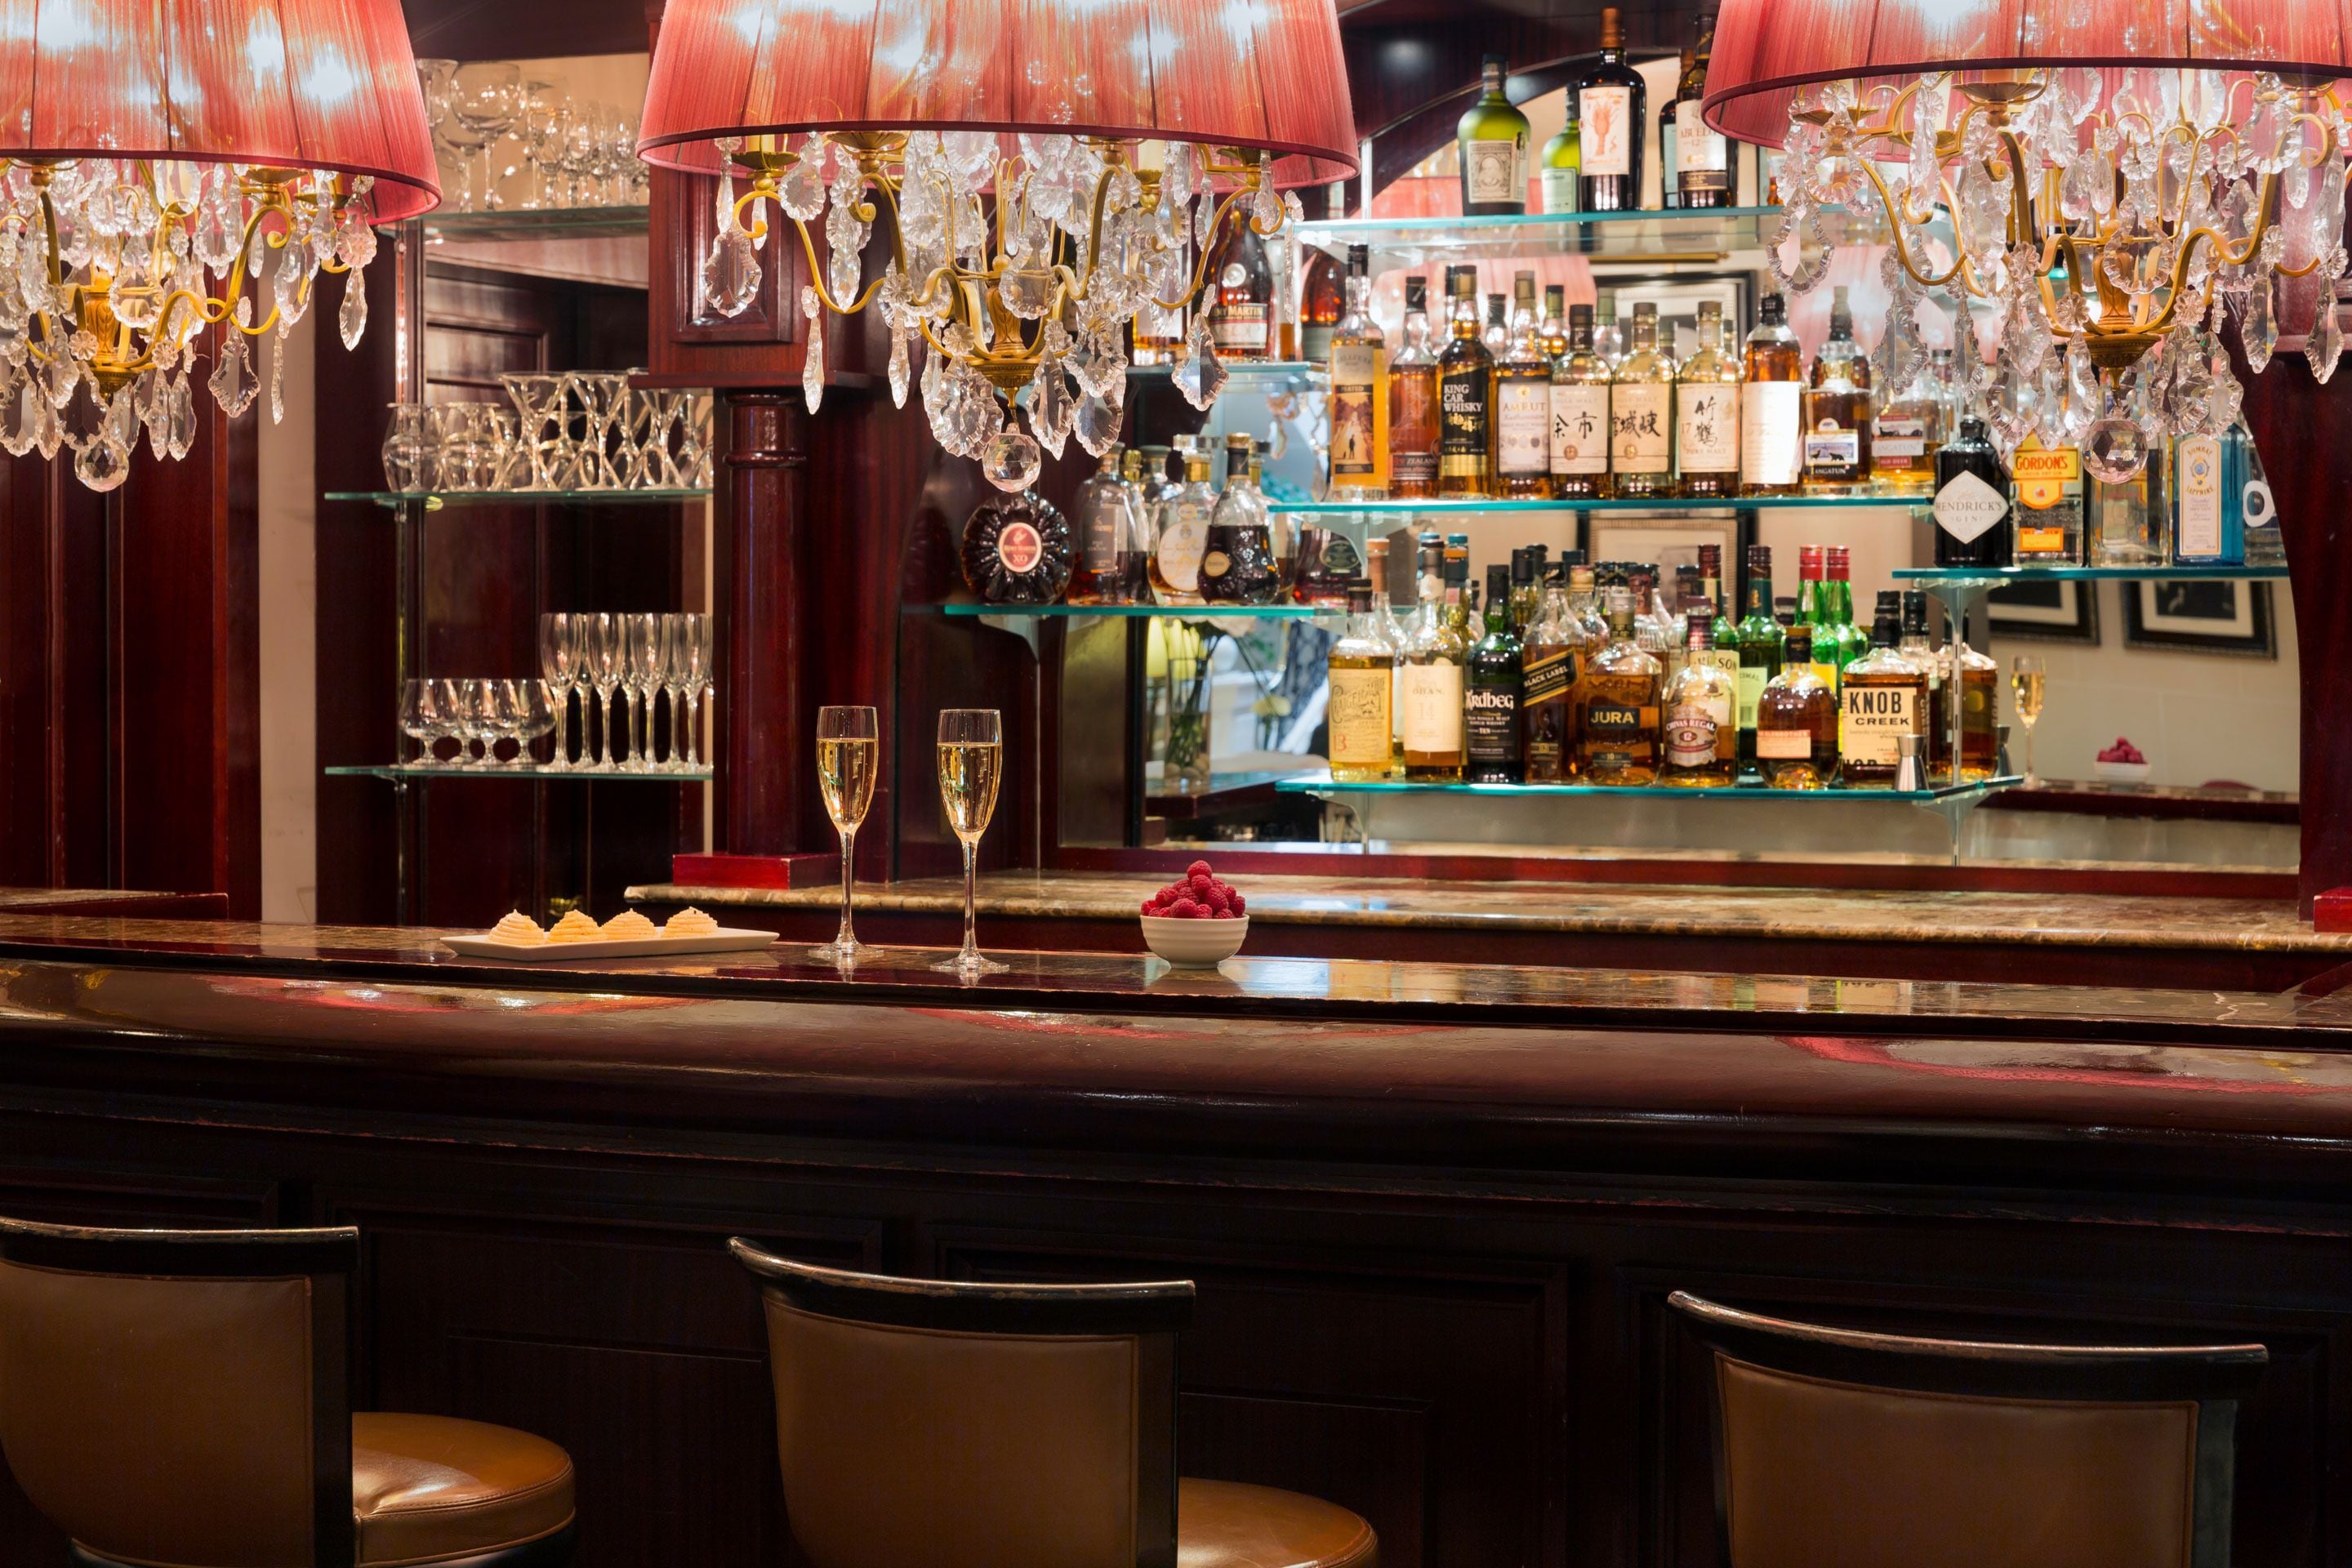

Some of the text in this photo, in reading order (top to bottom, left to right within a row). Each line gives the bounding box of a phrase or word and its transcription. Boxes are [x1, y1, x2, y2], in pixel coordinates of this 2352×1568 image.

[1228, 305, 1263, 316] MARTIN
[1443, 384, 1469, 394] KING
[1443, 394, 1464, 403] CAR
[1443, 403, 1483, 412] WHISKY
[1503, 403, 1546, 411] AMRUT
[1681, 422, 1691, 434] 17
[1936, 501, 2002, 511] HENDRICK'S
[1013, 554, 1028, 564] XO
[1524, 674, 1546, 688] BLACK
[1546, 665, 1569, 679] LABEL
[1850, 691, 1902, 714] KNOB
[1591, 711, 1635, 724] JURA
[1855, 717, 1909, 726] CREEK
[1666, 719, 1716, 732] CHIVAS REGAL
[1683, 733, 1692, 741] 12
[1333, 733, 1347, 752] 13
